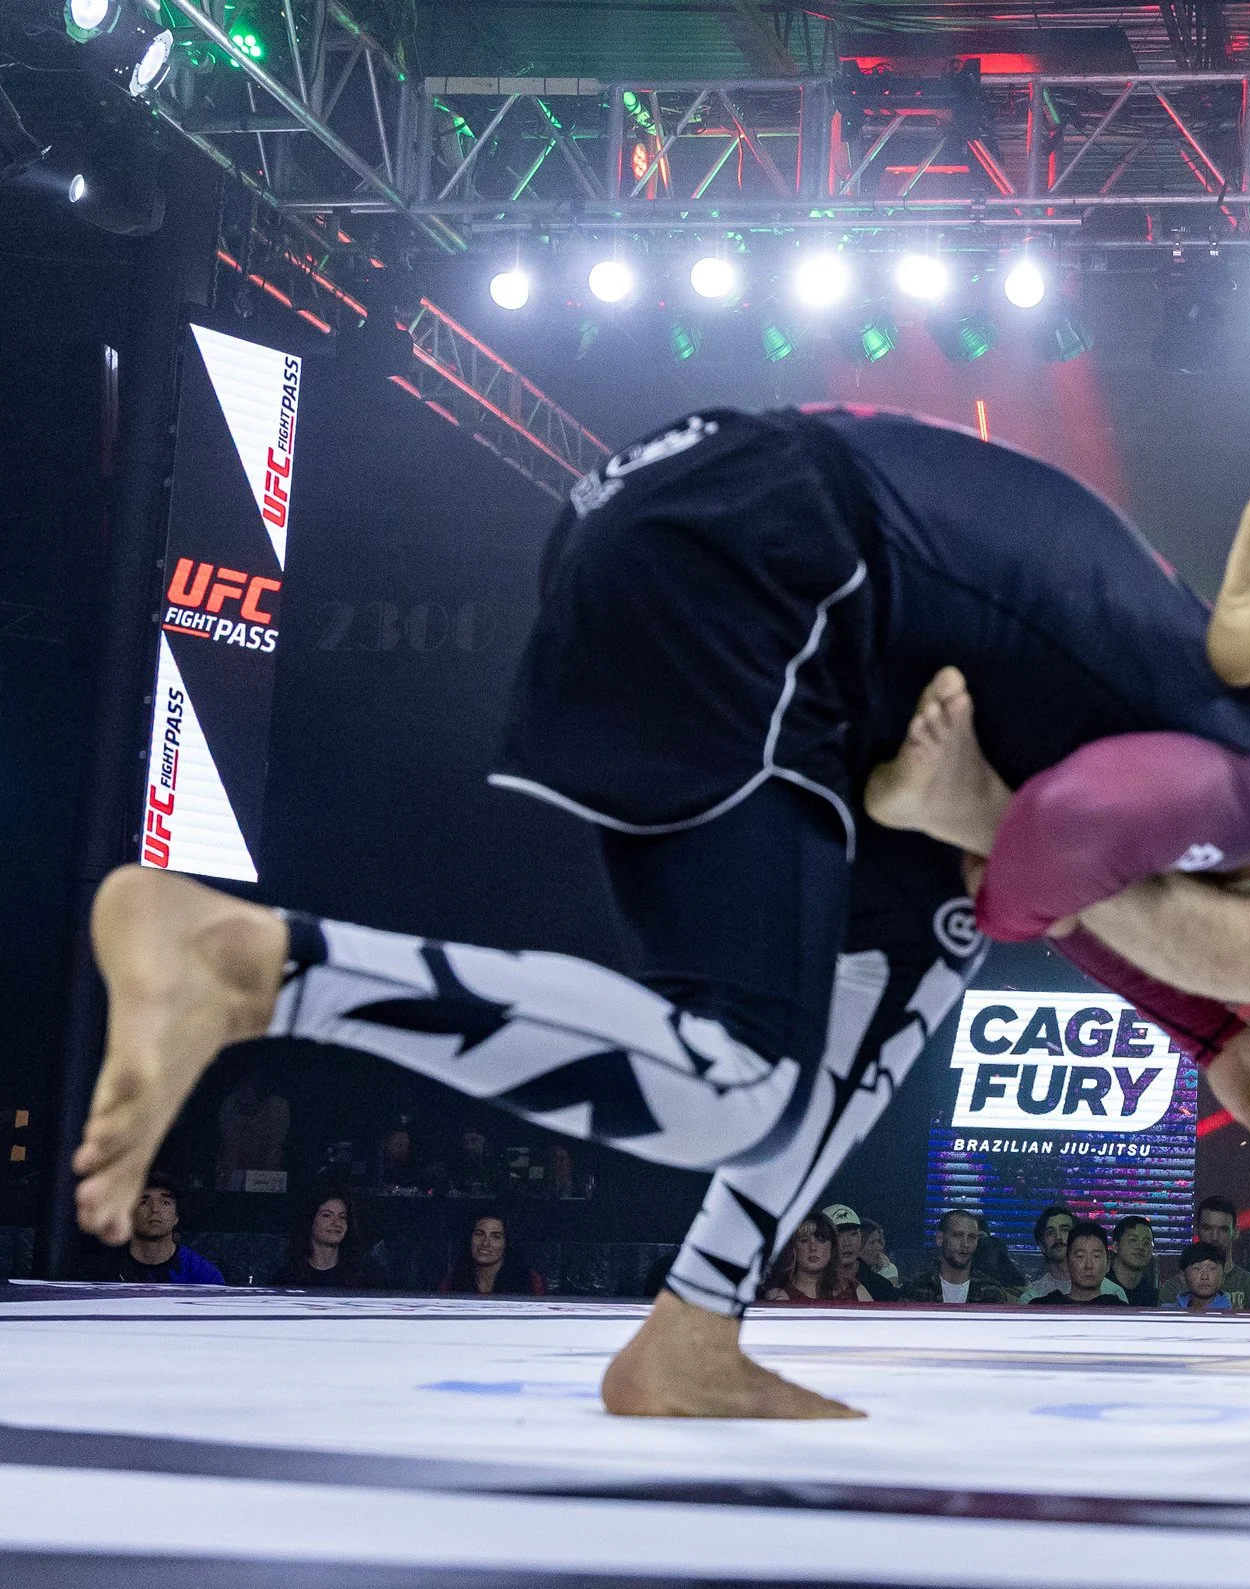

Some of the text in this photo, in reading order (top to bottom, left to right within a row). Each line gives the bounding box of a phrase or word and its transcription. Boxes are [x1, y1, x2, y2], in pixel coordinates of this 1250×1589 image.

[262, 447, 291, 528] UFC
[167, 558, 282, 625] UFC
[144, 785, 175, 869] UFC
[969, 1004, 1156, 1058] CAGE
[969, 1063, 1164, 1117] FURY
[953, 1138, 1151, 1156] BRAZILIAN JIU-JITSU
